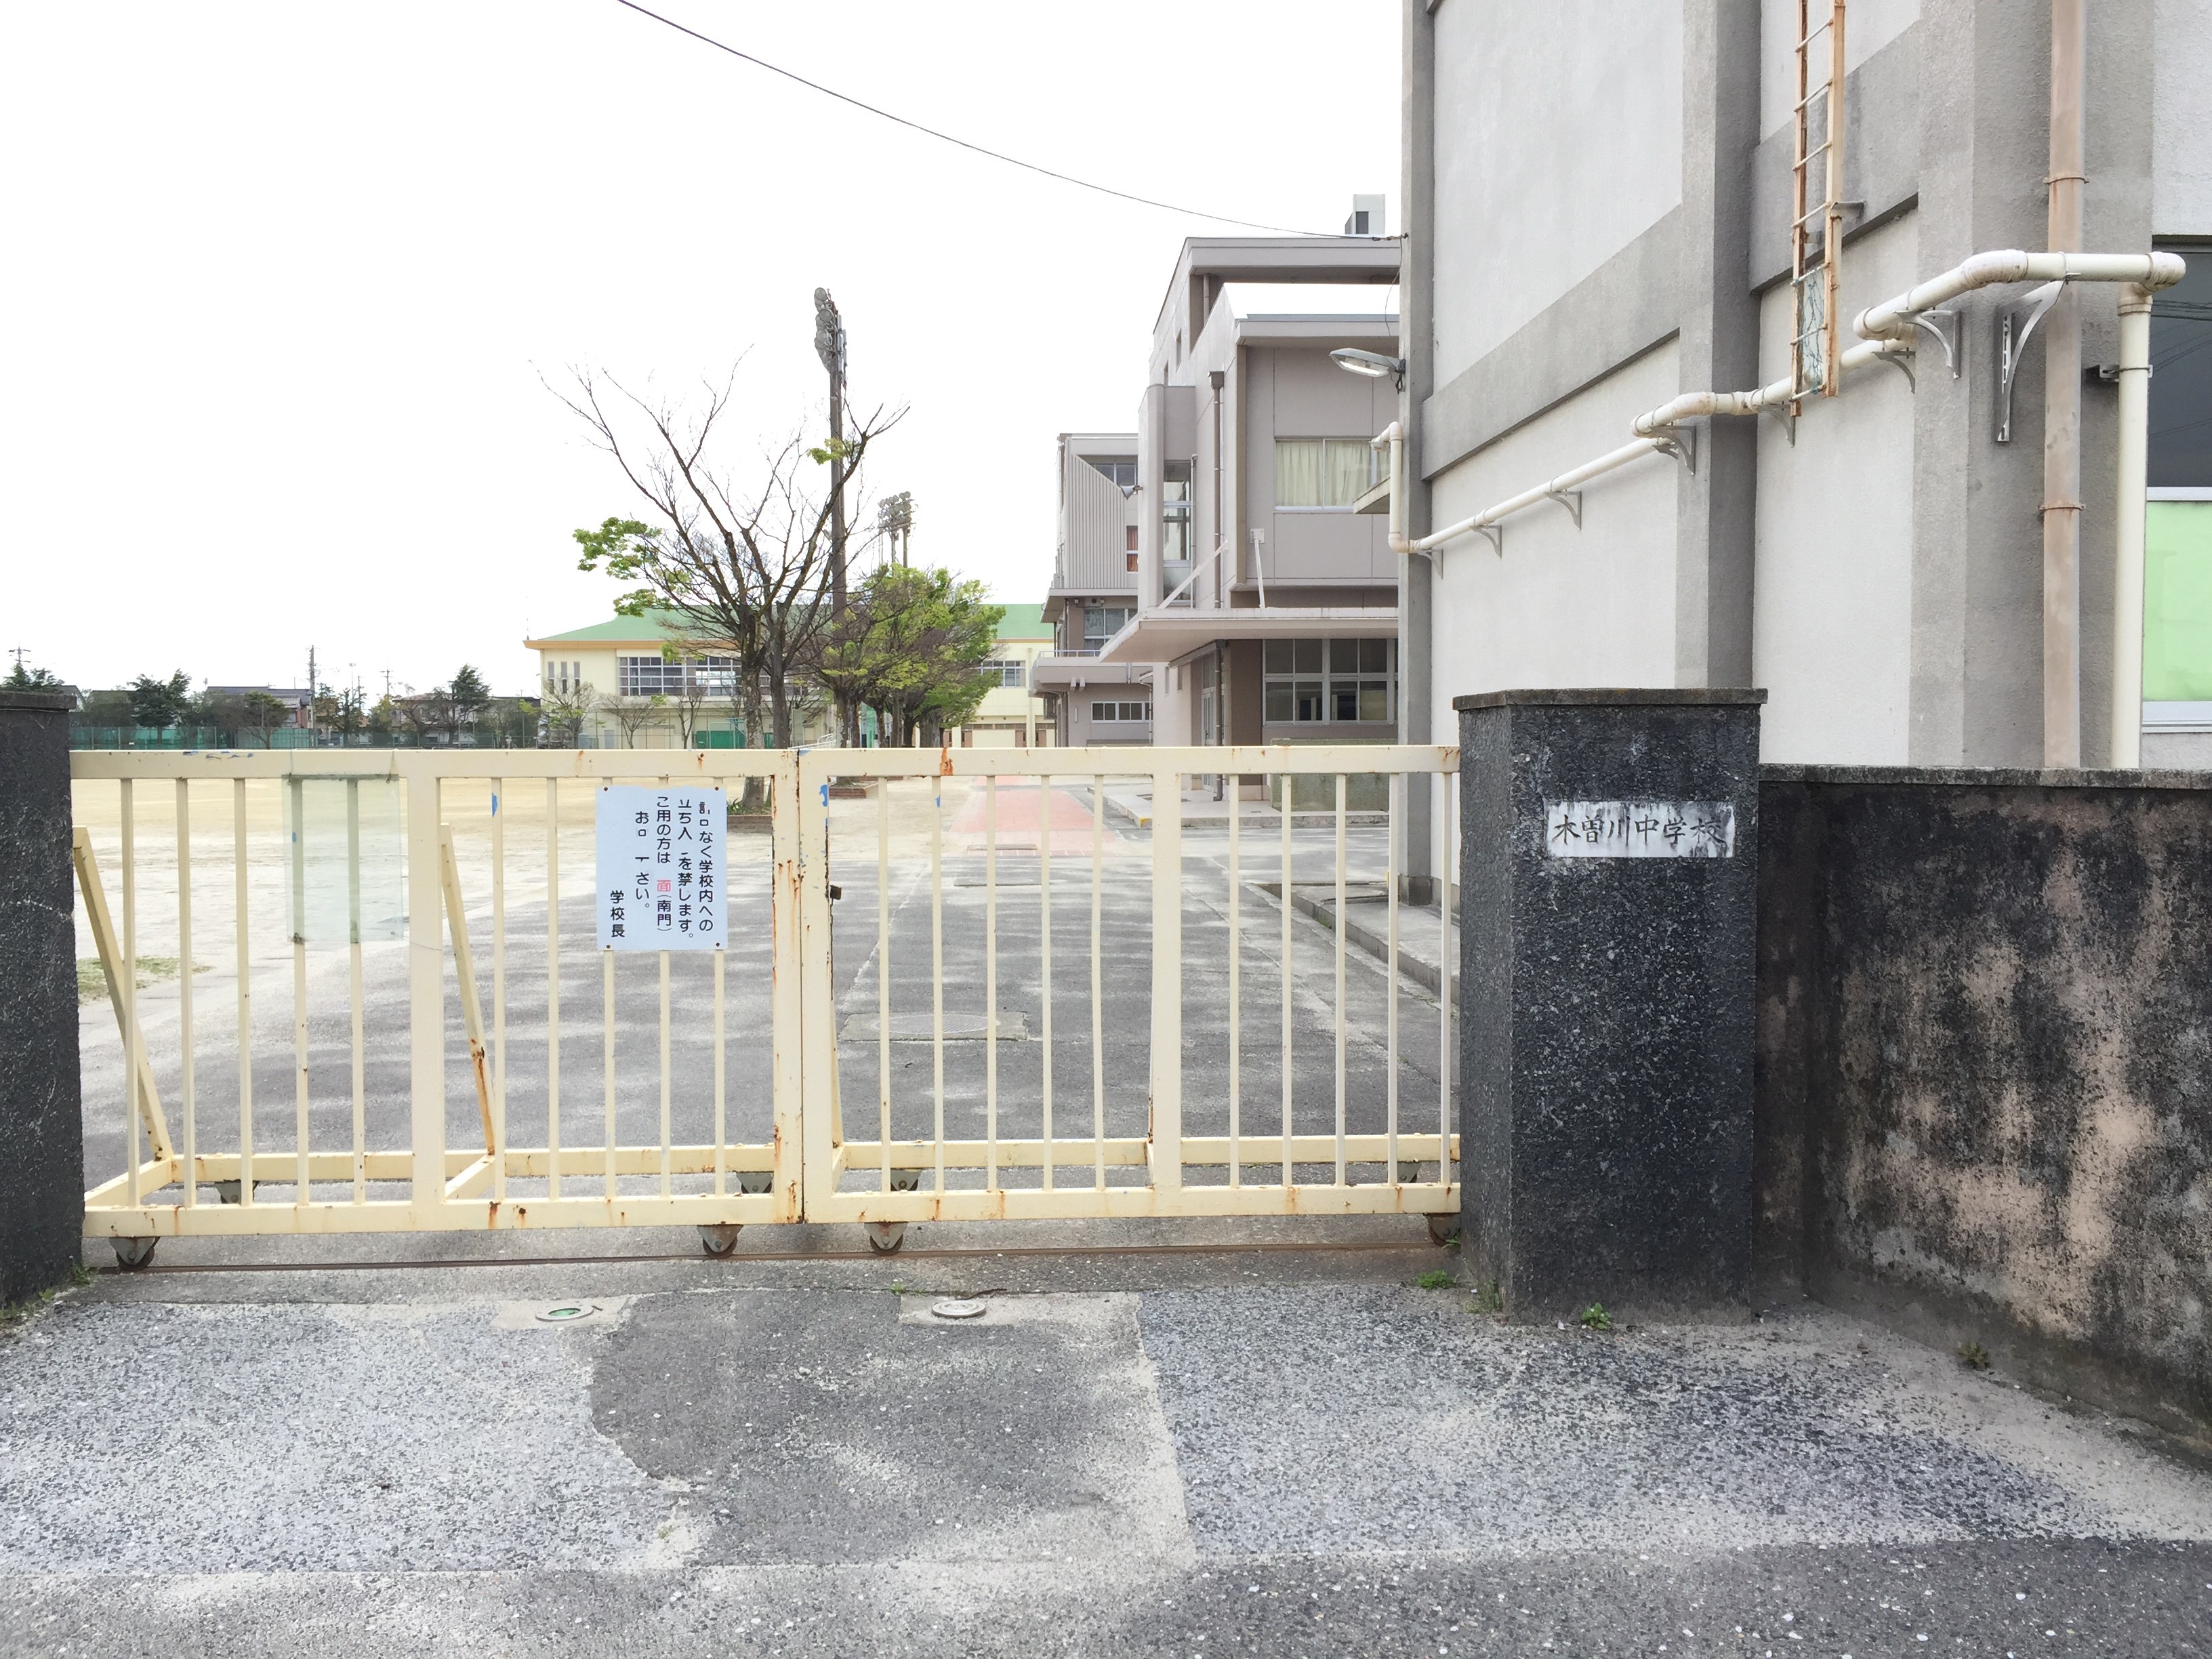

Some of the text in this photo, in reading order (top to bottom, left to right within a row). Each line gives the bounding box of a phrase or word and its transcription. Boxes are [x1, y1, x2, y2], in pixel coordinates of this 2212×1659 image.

[611, 890, 626, 938] 学校長
[678, 799, 694, 938] 立ち入を禁します。
